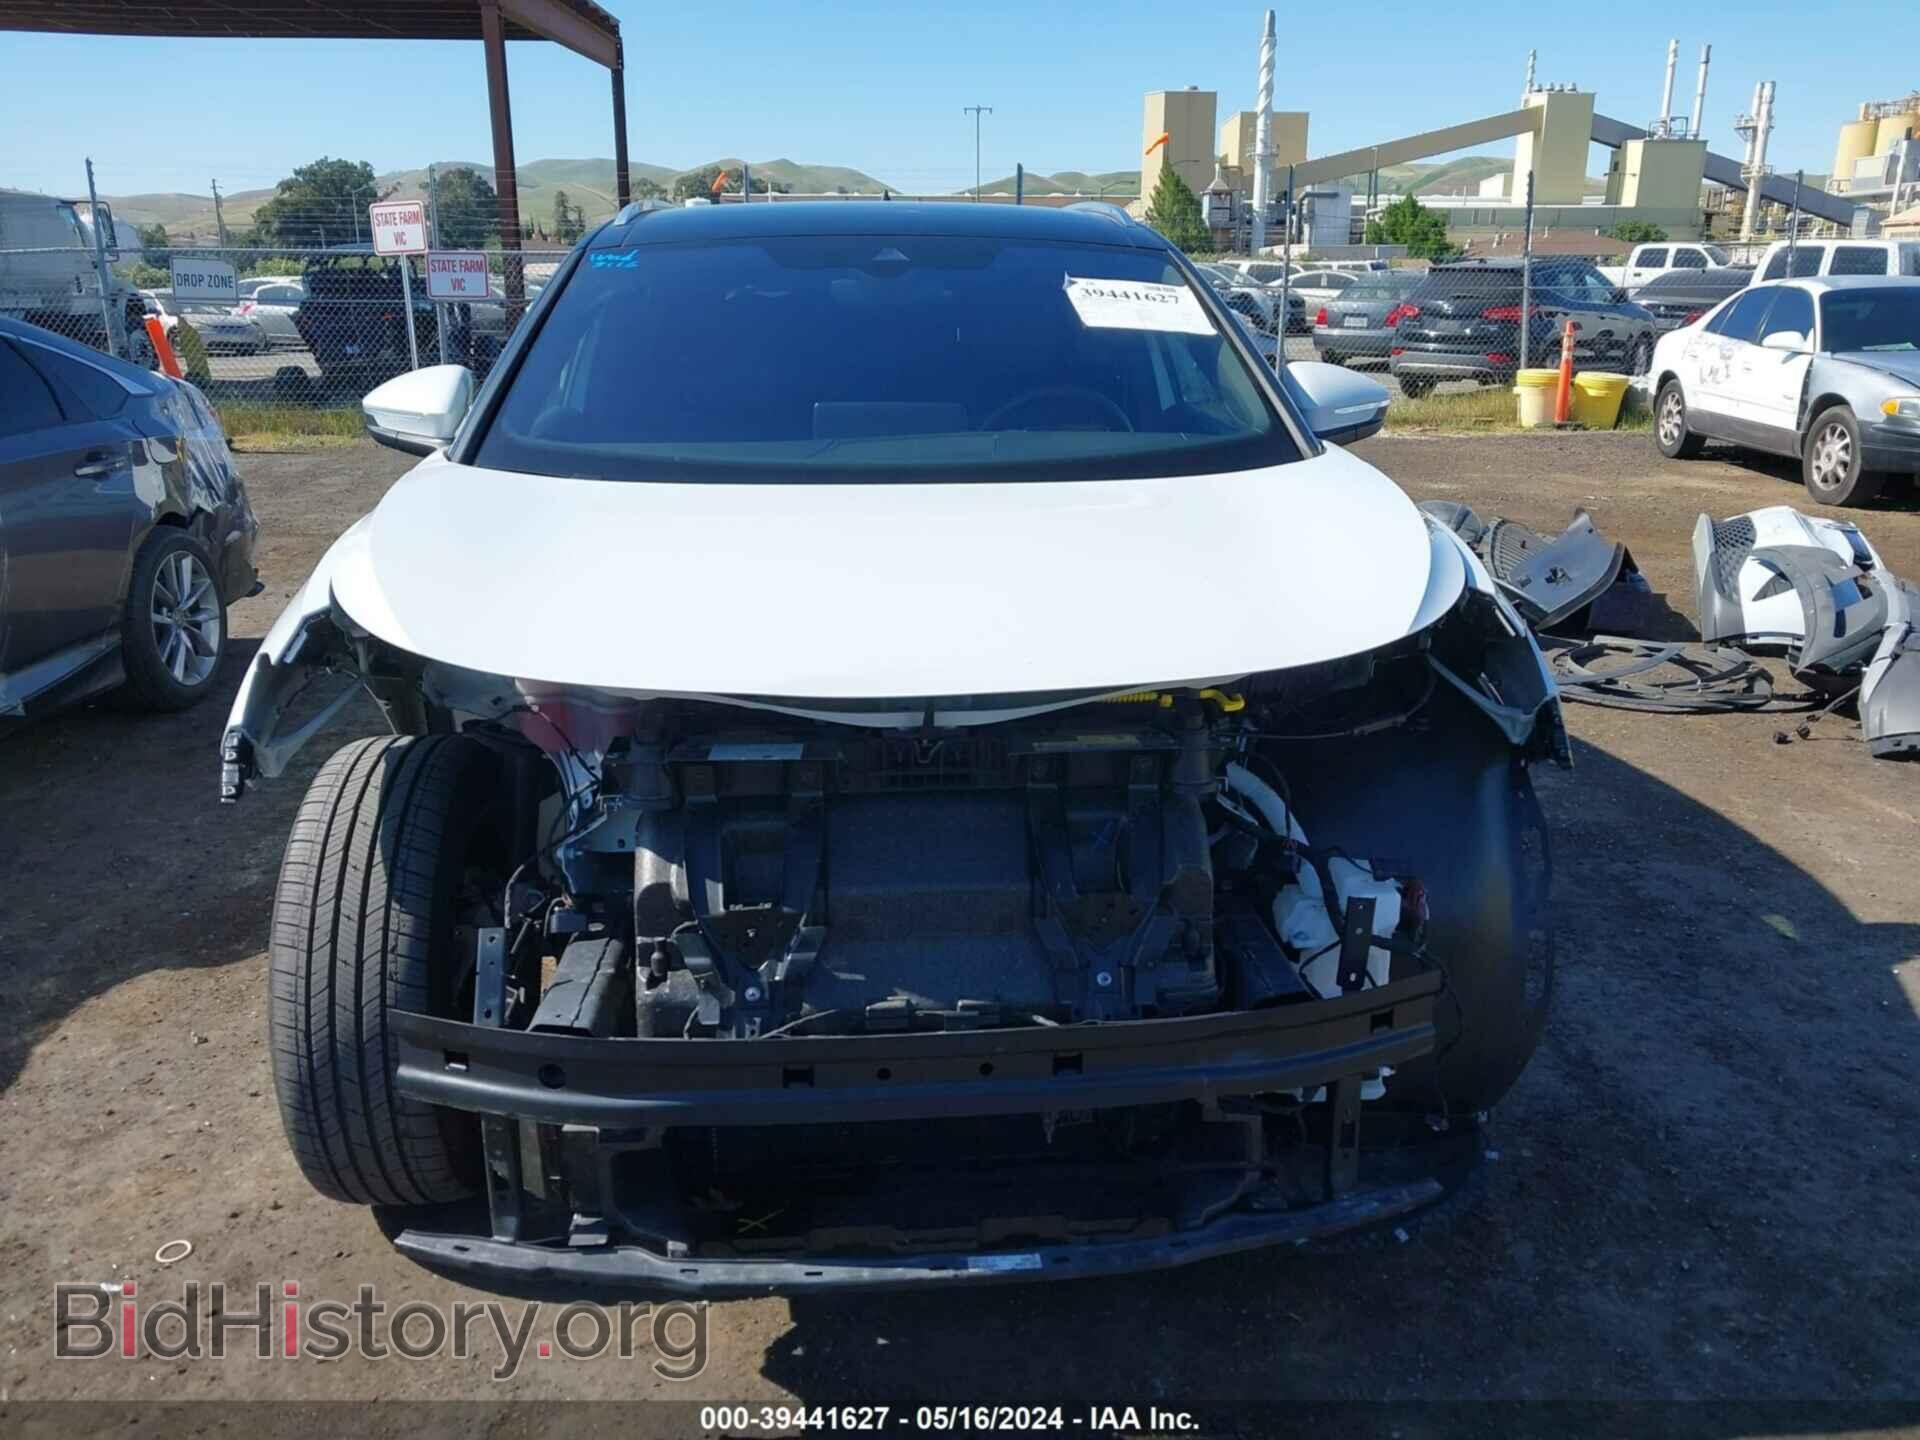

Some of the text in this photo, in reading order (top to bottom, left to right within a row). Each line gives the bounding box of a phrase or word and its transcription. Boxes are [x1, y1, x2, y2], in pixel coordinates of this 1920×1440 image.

[375, 210, 421, 227] STATE FARM
[393, 231, 407, 246] VIC
[431, 260, 484, 272] STATE FARM
[176, 273, 234, 288] DROP ZONE
[451, 278, 466, 291] VIC
[1081, 288, 1178, 304] 39441627
